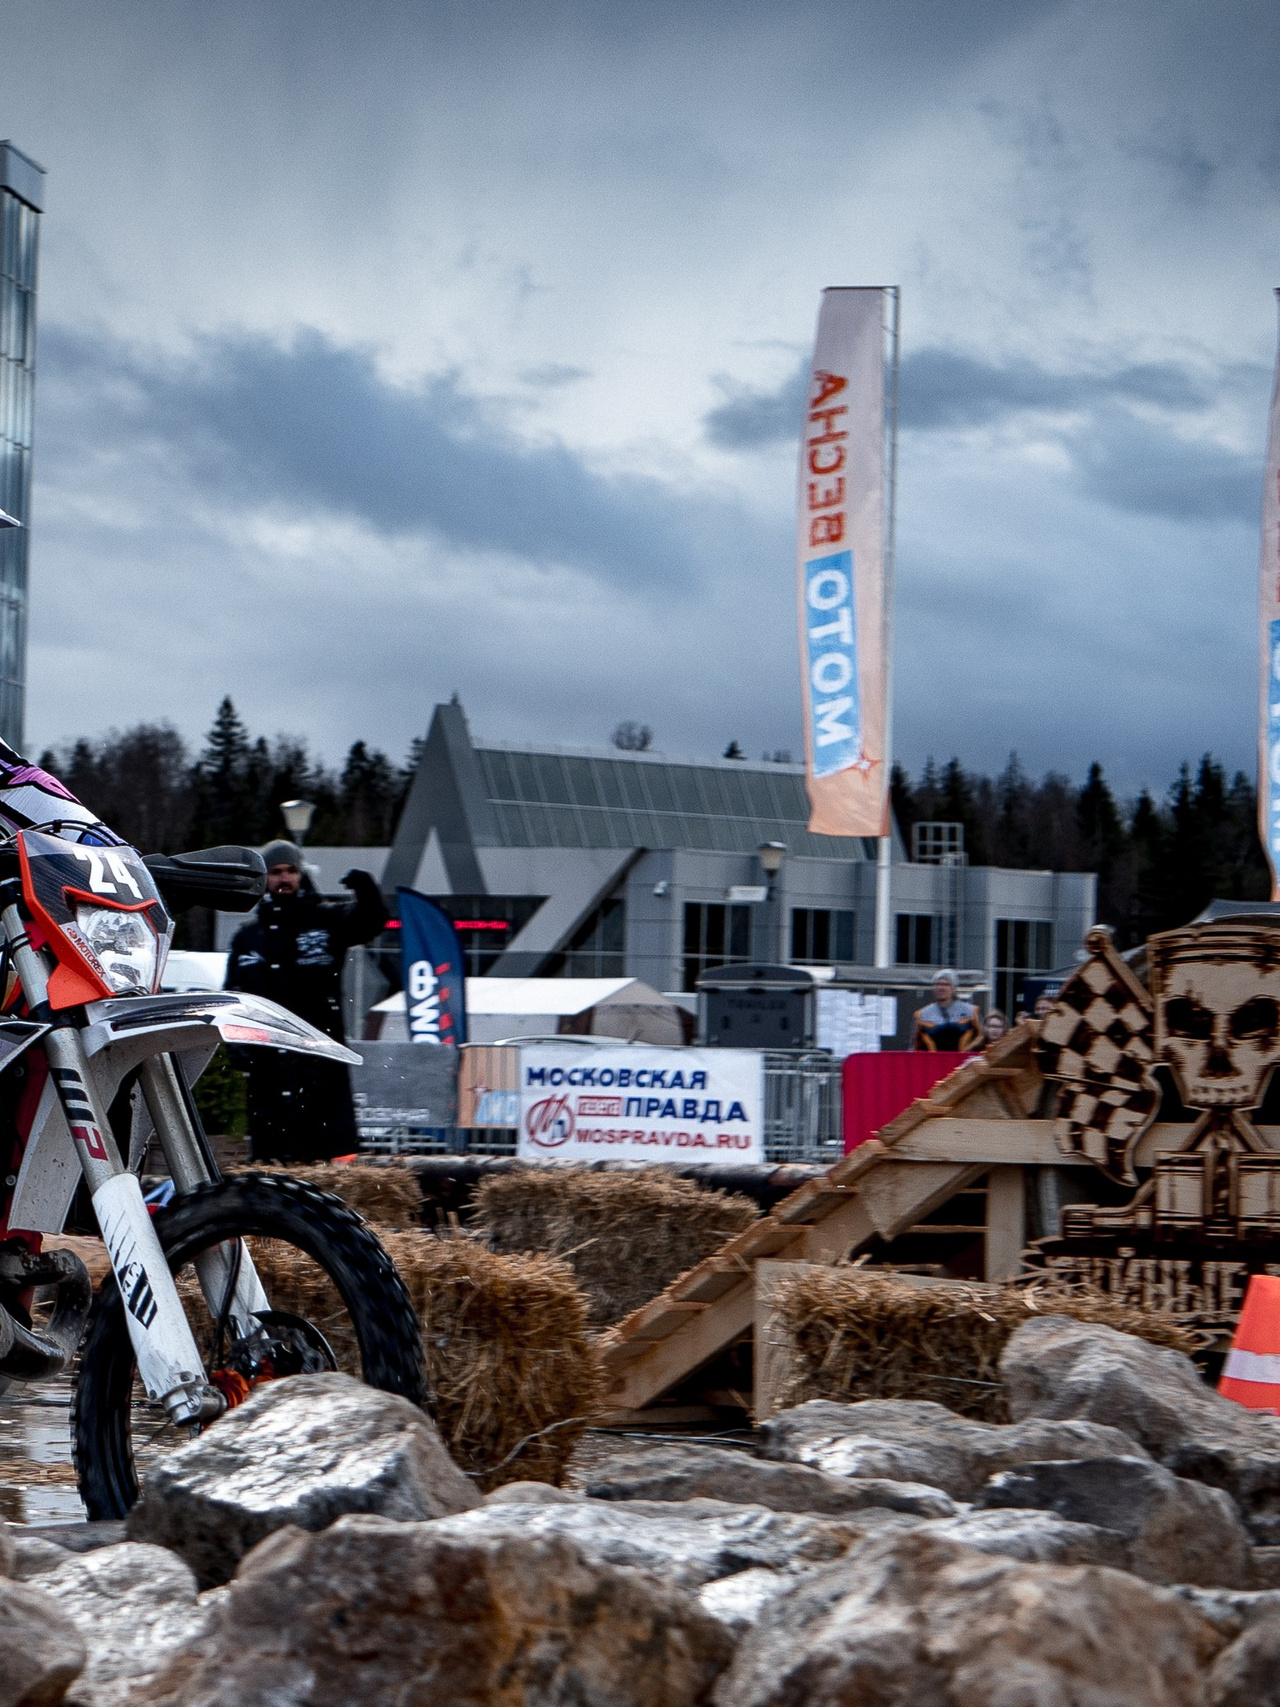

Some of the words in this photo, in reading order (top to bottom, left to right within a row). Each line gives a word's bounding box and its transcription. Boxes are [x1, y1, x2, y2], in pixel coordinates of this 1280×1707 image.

[72, 847, 144, 900] 24
[75, 937, 107, 978] MOTOREX
[525, 1066, 708, 1090] МОСКОВСКАЯ
[625, 1097, 748, 1124] ПРАВДА
[576, 1128, 752, 1150] MOSPRAVDA.RU
